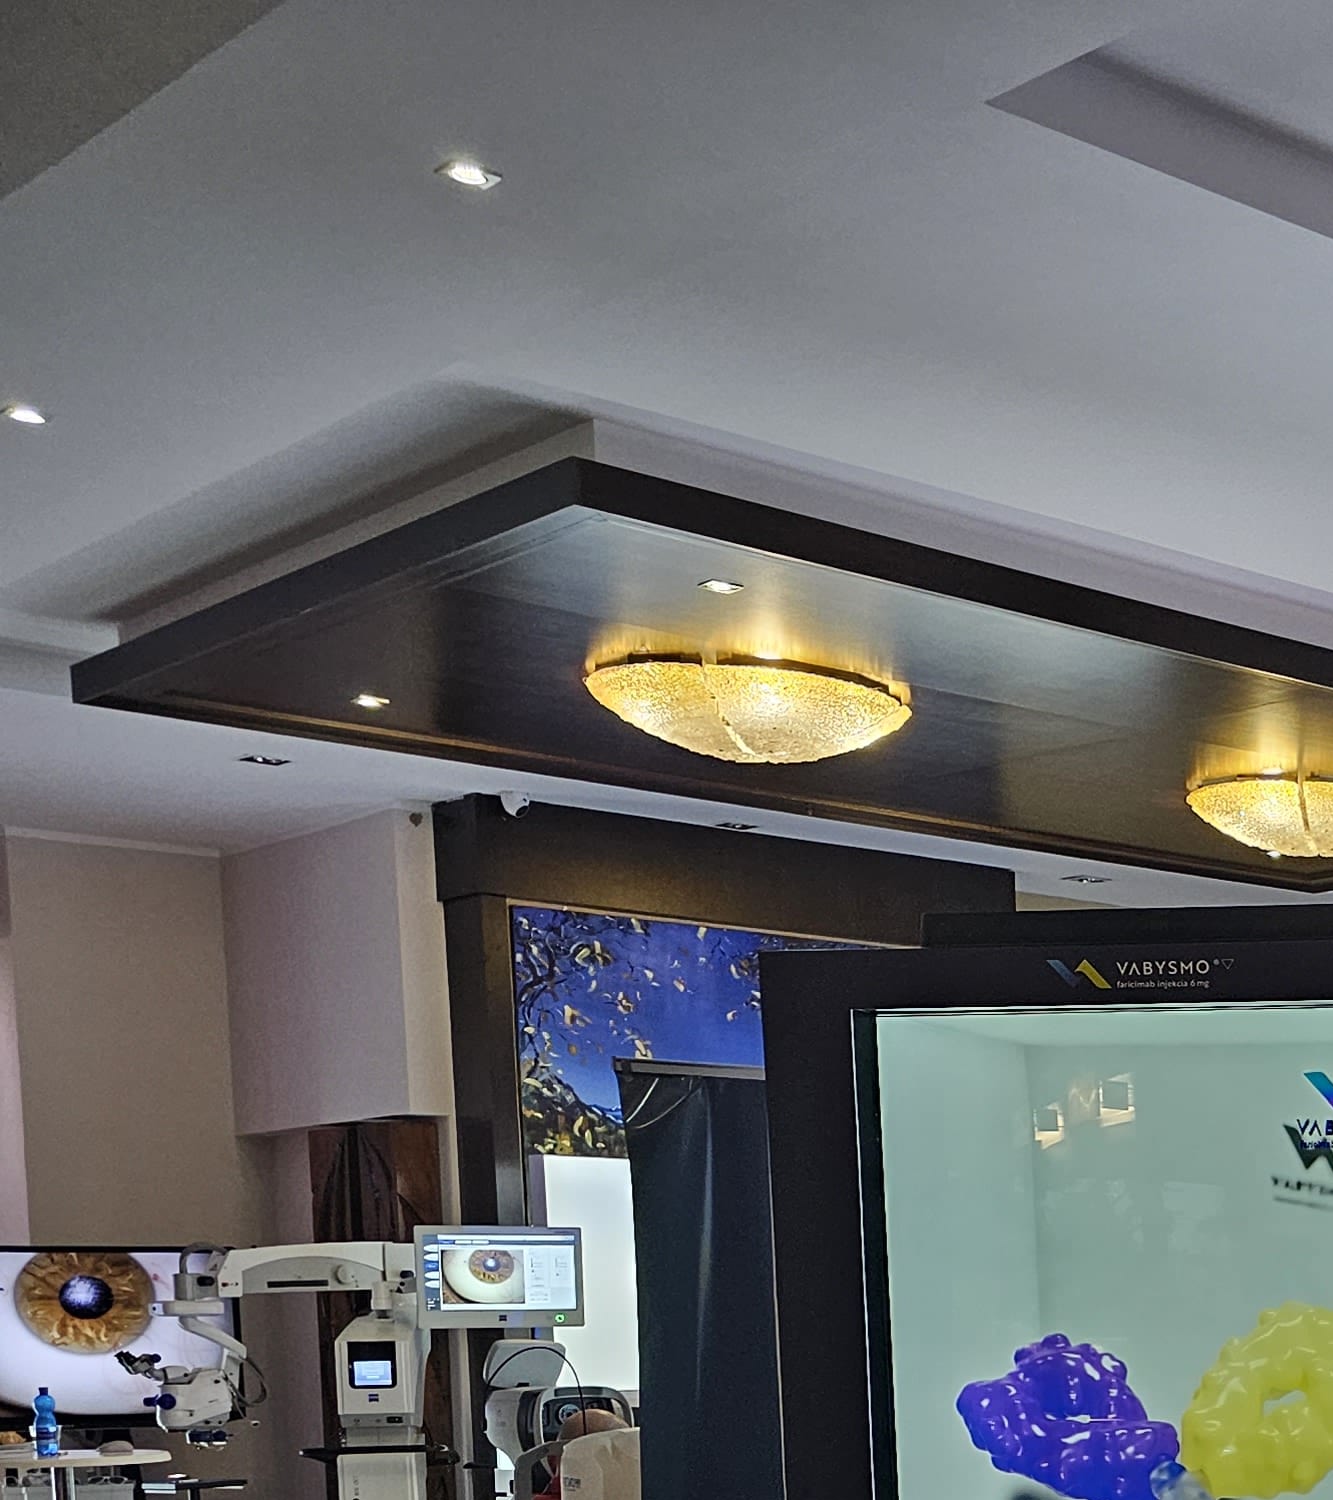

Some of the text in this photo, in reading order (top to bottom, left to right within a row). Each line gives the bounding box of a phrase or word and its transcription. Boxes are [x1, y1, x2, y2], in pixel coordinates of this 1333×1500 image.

[1116, 959, 1210, 976] VABYSMO
[1116, 980, 1156, 988] faricimab
[1156, 980, 1188, 990] injekcia
[1196, 981, 1210, 989] mg
